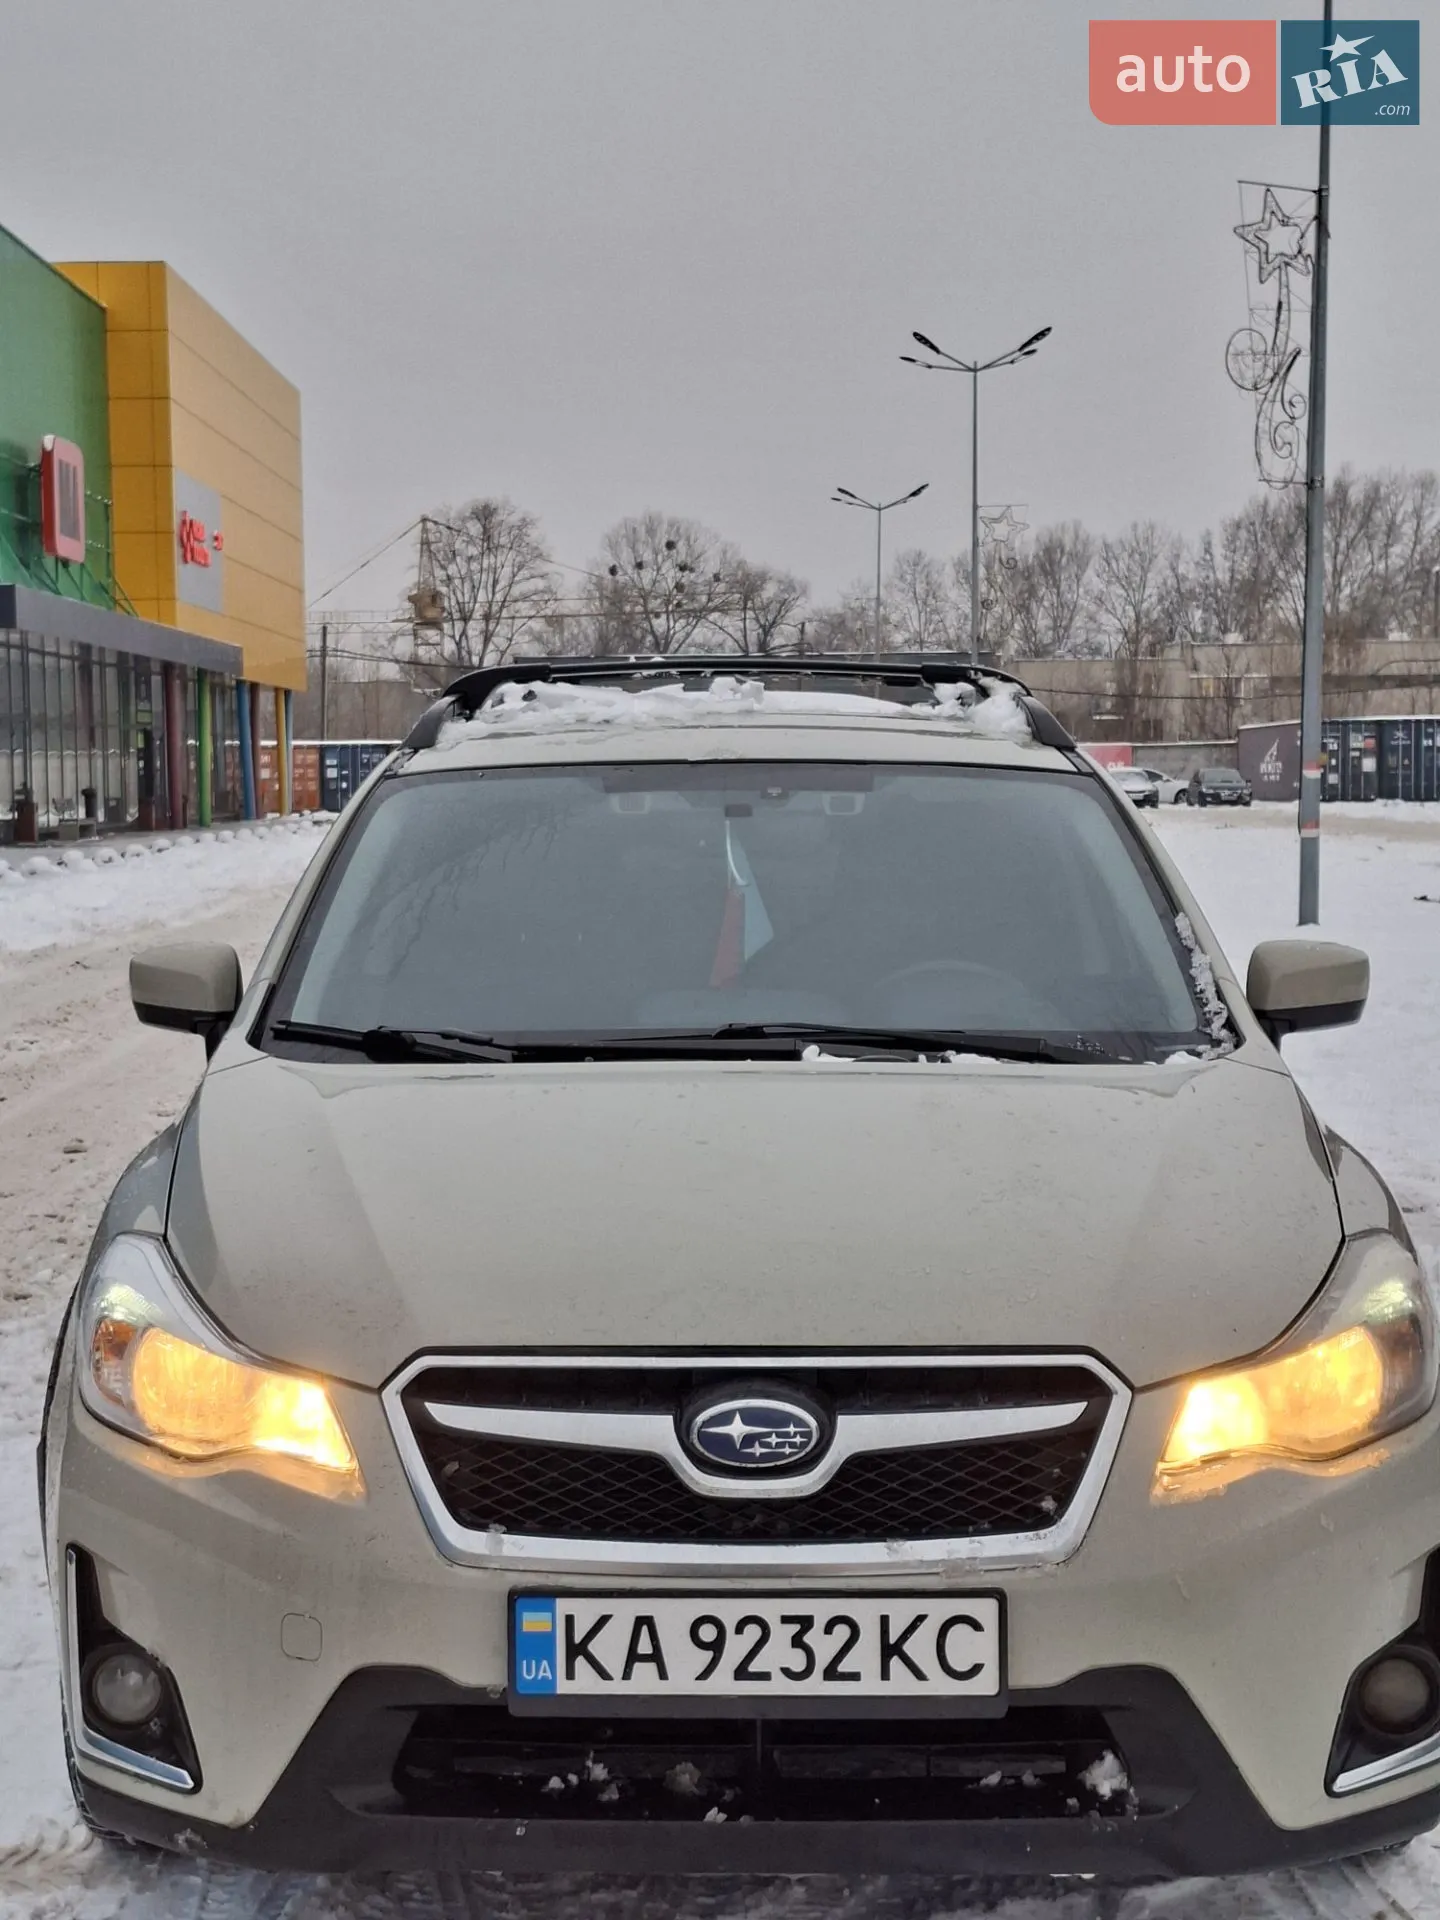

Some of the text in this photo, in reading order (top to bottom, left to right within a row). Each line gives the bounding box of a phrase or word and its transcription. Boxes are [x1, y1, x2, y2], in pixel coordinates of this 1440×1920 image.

[564, 1613, 986, 1682] KA 9232 KC
[522, 1660, 553, 1680] UA
